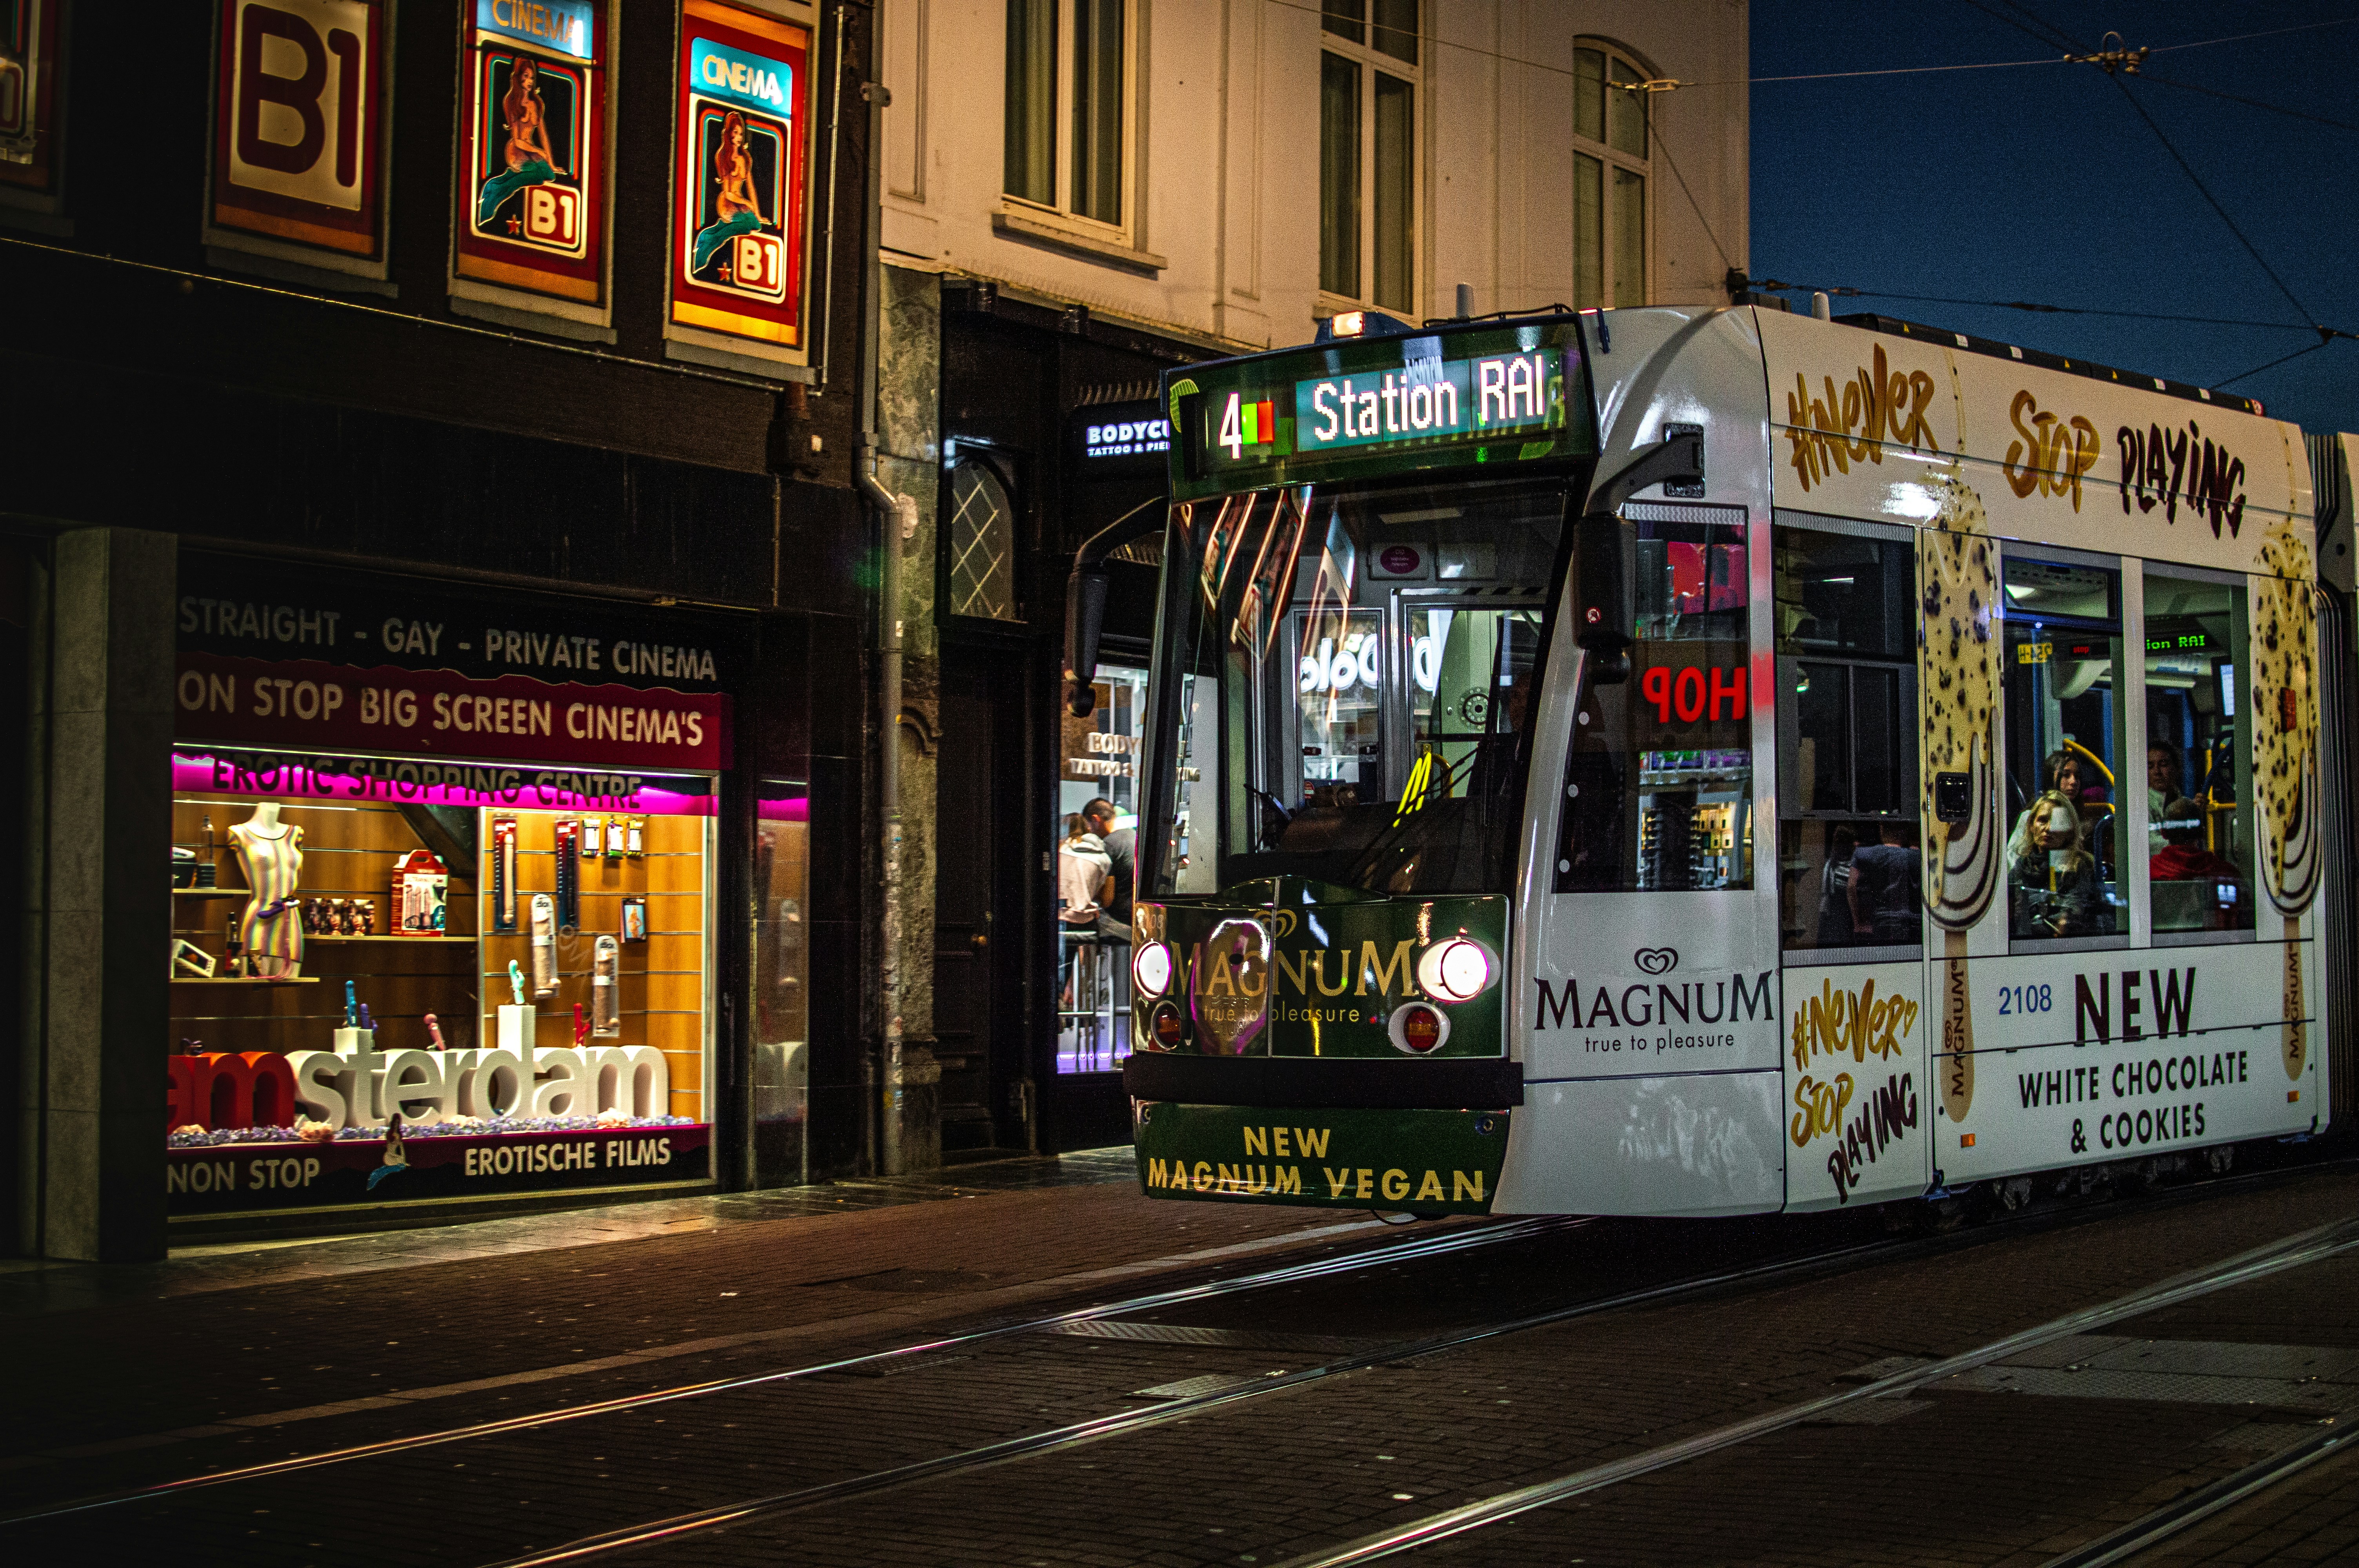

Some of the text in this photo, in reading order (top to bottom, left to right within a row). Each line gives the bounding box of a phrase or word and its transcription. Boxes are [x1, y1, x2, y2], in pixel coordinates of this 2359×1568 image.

[238, 3, 361, 188] B1
[702, 55, 783, 105] CINEMA
[531, 189, 575, 240] B1
[738, 240, 778, 285] B1
[1218, 354, 1544, 460] 4 Station RAI
[1087, 445, 1132, 457] TATTOO
[1134, 443, 1143, 453] &
[2003, 390, 2100, 514] STOP
[180, 596, 340, 646] STRAIGHT
[382, 617, 443, 655] GAY
[485, 628, 601, 670] PRIVATE
[612, 641, 717, 681] CINEMA
[2178, 635, 2205, 648] RAI
[253, 677, 344, 721] STOP
[360, 687, 419, 728] BIG
[433, 693, 551, 736] SCREEN
[566, 702, 704, 746] CINEMA'S
[213, 753, 642, 808] EROTIC SHOPPING CENTRE
[1166, 938, 1417, 996] MAGNUM
[1534, 969, 1774, 1030] MAGNUM
[1999, 984, 2052, 1015] 2108
[2075, 966, 2196, 1045] NEW
[1585, 1029, 1734, 1055] true to pleasure
[1951, 970, 1965, 1097] MAGNUM
[2018, 1051, 2247, 1109] WHITE CHOCOLATE
[1790, 1072, 1855, 1148] STOP
[2070, 1102, 2206, 1154] & COOKIES
[465, 1138, 671, 1176] EROTISCHE FILMS
[1243, 1126, 1330, 1158] NEW
[167, 1158, 320, 1193] NON STOP
[1148, 1157, 1484, 1202] MAGNUM VEGAN
